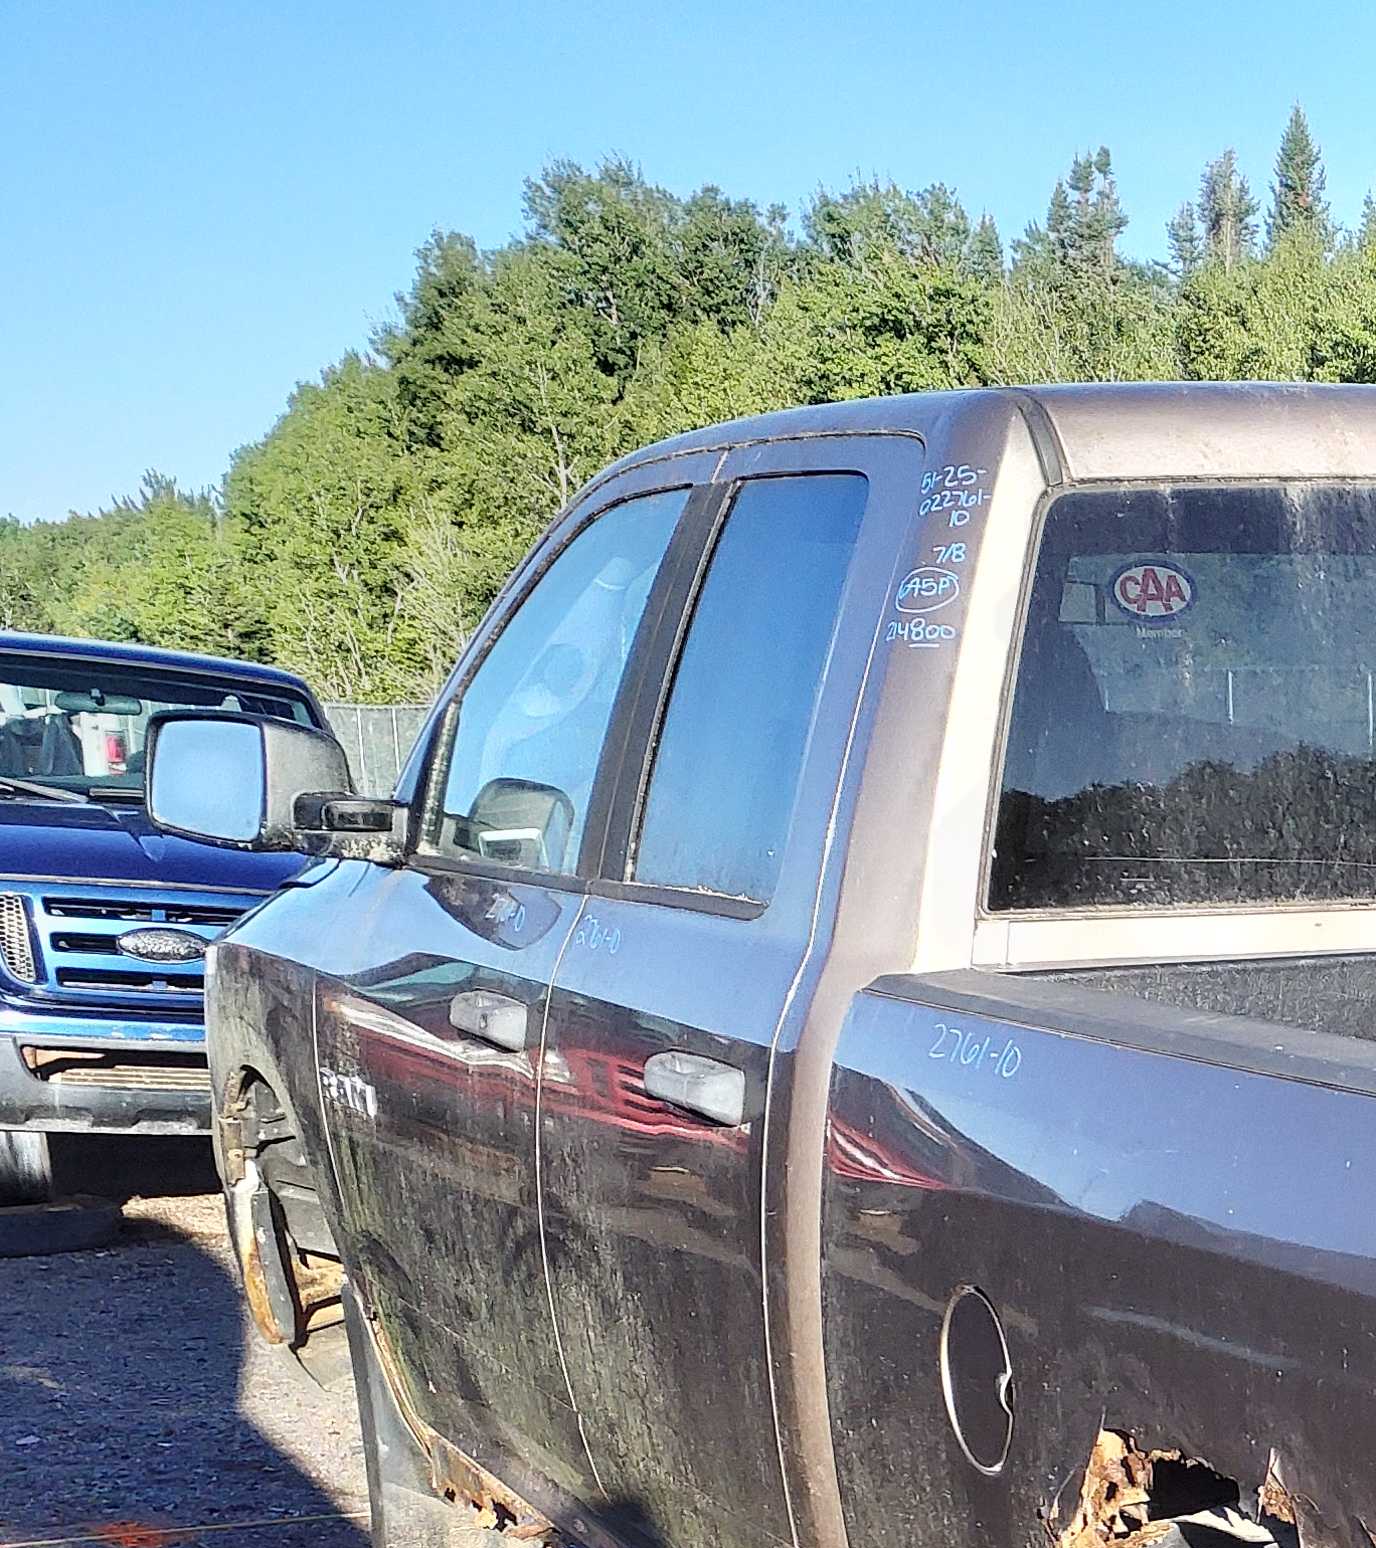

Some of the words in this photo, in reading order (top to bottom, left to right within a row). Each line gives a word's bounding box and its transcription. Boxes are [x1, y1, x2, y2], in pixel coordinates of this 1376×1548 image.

[949, 510, 970, 527] 10
[1120, 567, 1186, 613] CAA
[928, 1023, 1021, 1077] 2761-10
